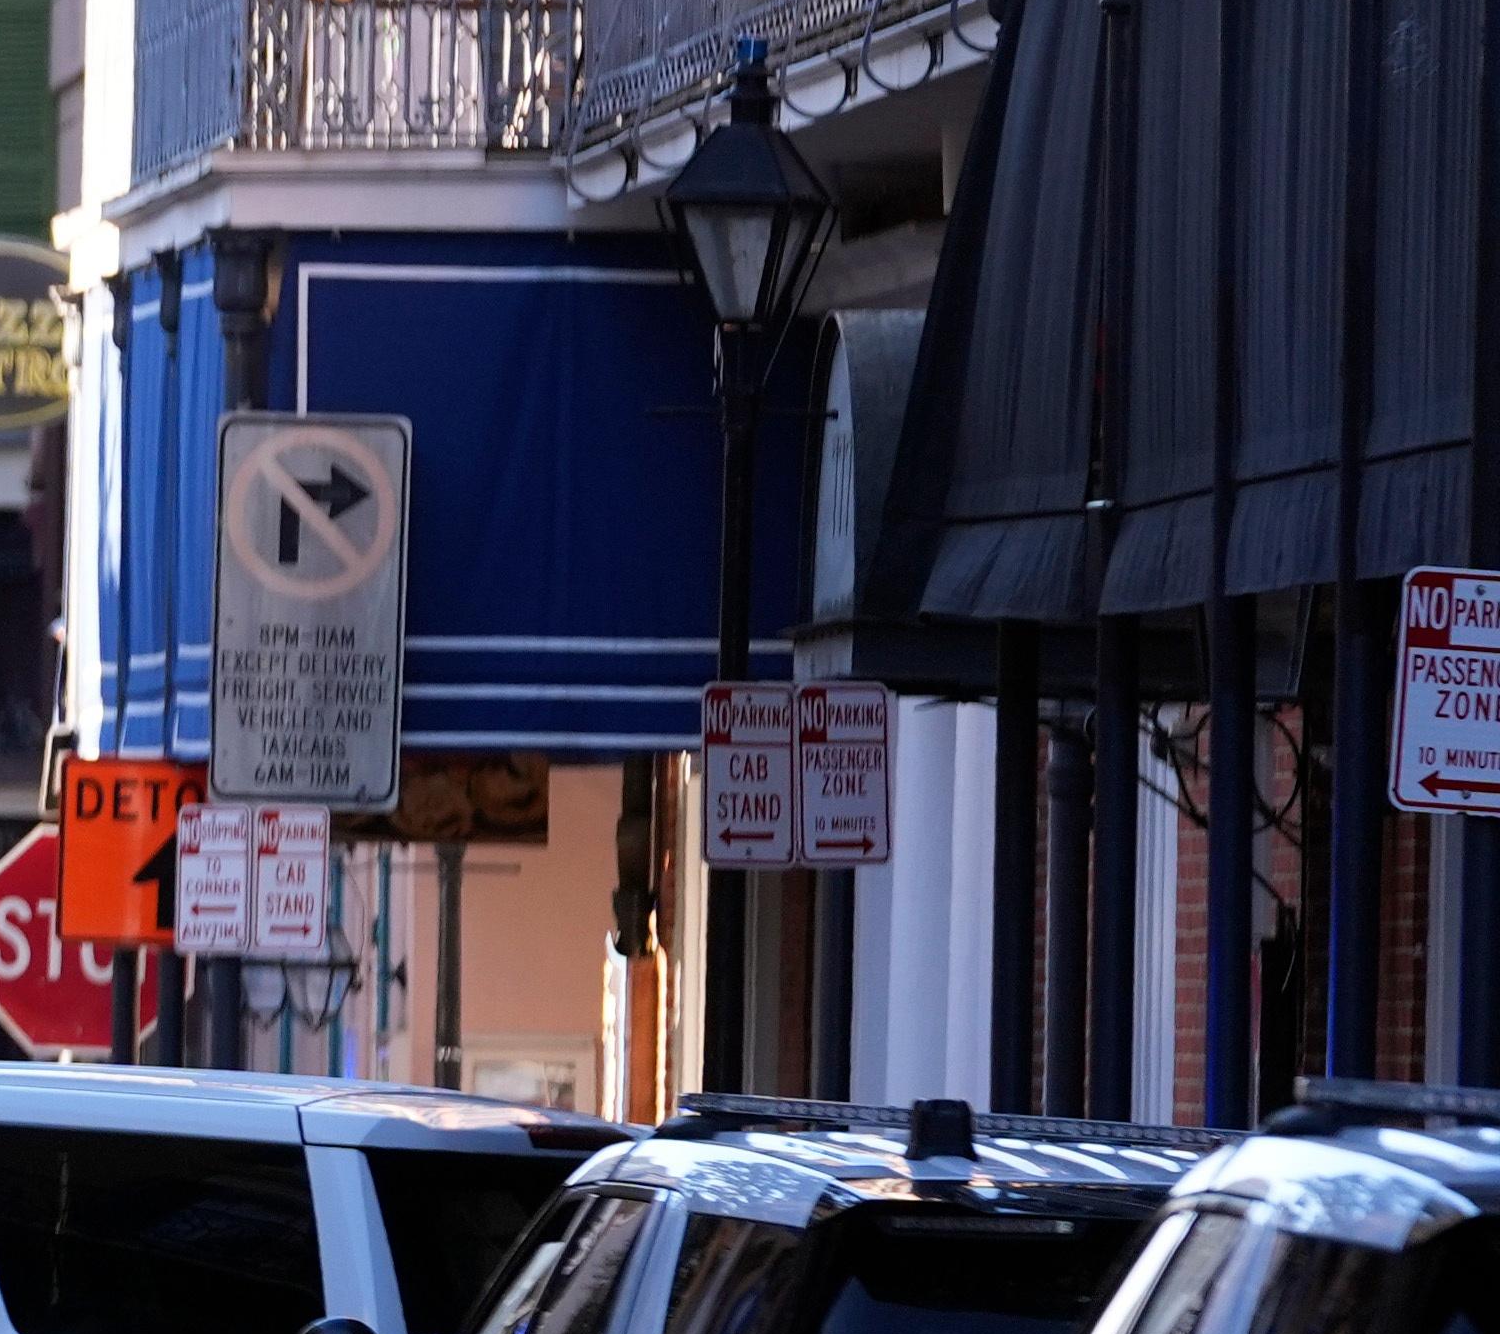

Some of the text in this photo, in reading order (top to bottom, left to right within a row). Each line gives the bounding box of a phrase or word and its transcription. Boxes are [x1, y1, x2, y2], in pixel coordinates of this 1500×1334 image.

[1409, 585, 1500, 630] NO PAR
[221, 650, 288, 675] EXCEPT
[312, 680, 386, 706] SERVICE
[334, 709, 373, 732] AND
[706, 696, 790, 733] NO PARKING
[801, 696, 885, 732] NO PARKING
[263, 735, 347, 758] TAXICABS
[1419, 746, 1436, 766] 10
[729, 753, 769, 781] CAB
[804, 748, 883, 771] PASSENGER
[822, 772, 869, 797] ZONE
[76, 777, 206, 822] DETO
[717, 791, 781, 821] STAND
[181, 818, 199, 844] NO
[259, 818, 325, 845] NO PARKING
[815, 816, 876, 833] 10 MINUTES
[207, 857, 221, 875] TO
[276, 861, 306, 884] CAB
[187, 878, 241, 895] CORNER
[267, 893, 315, 915] STAND
